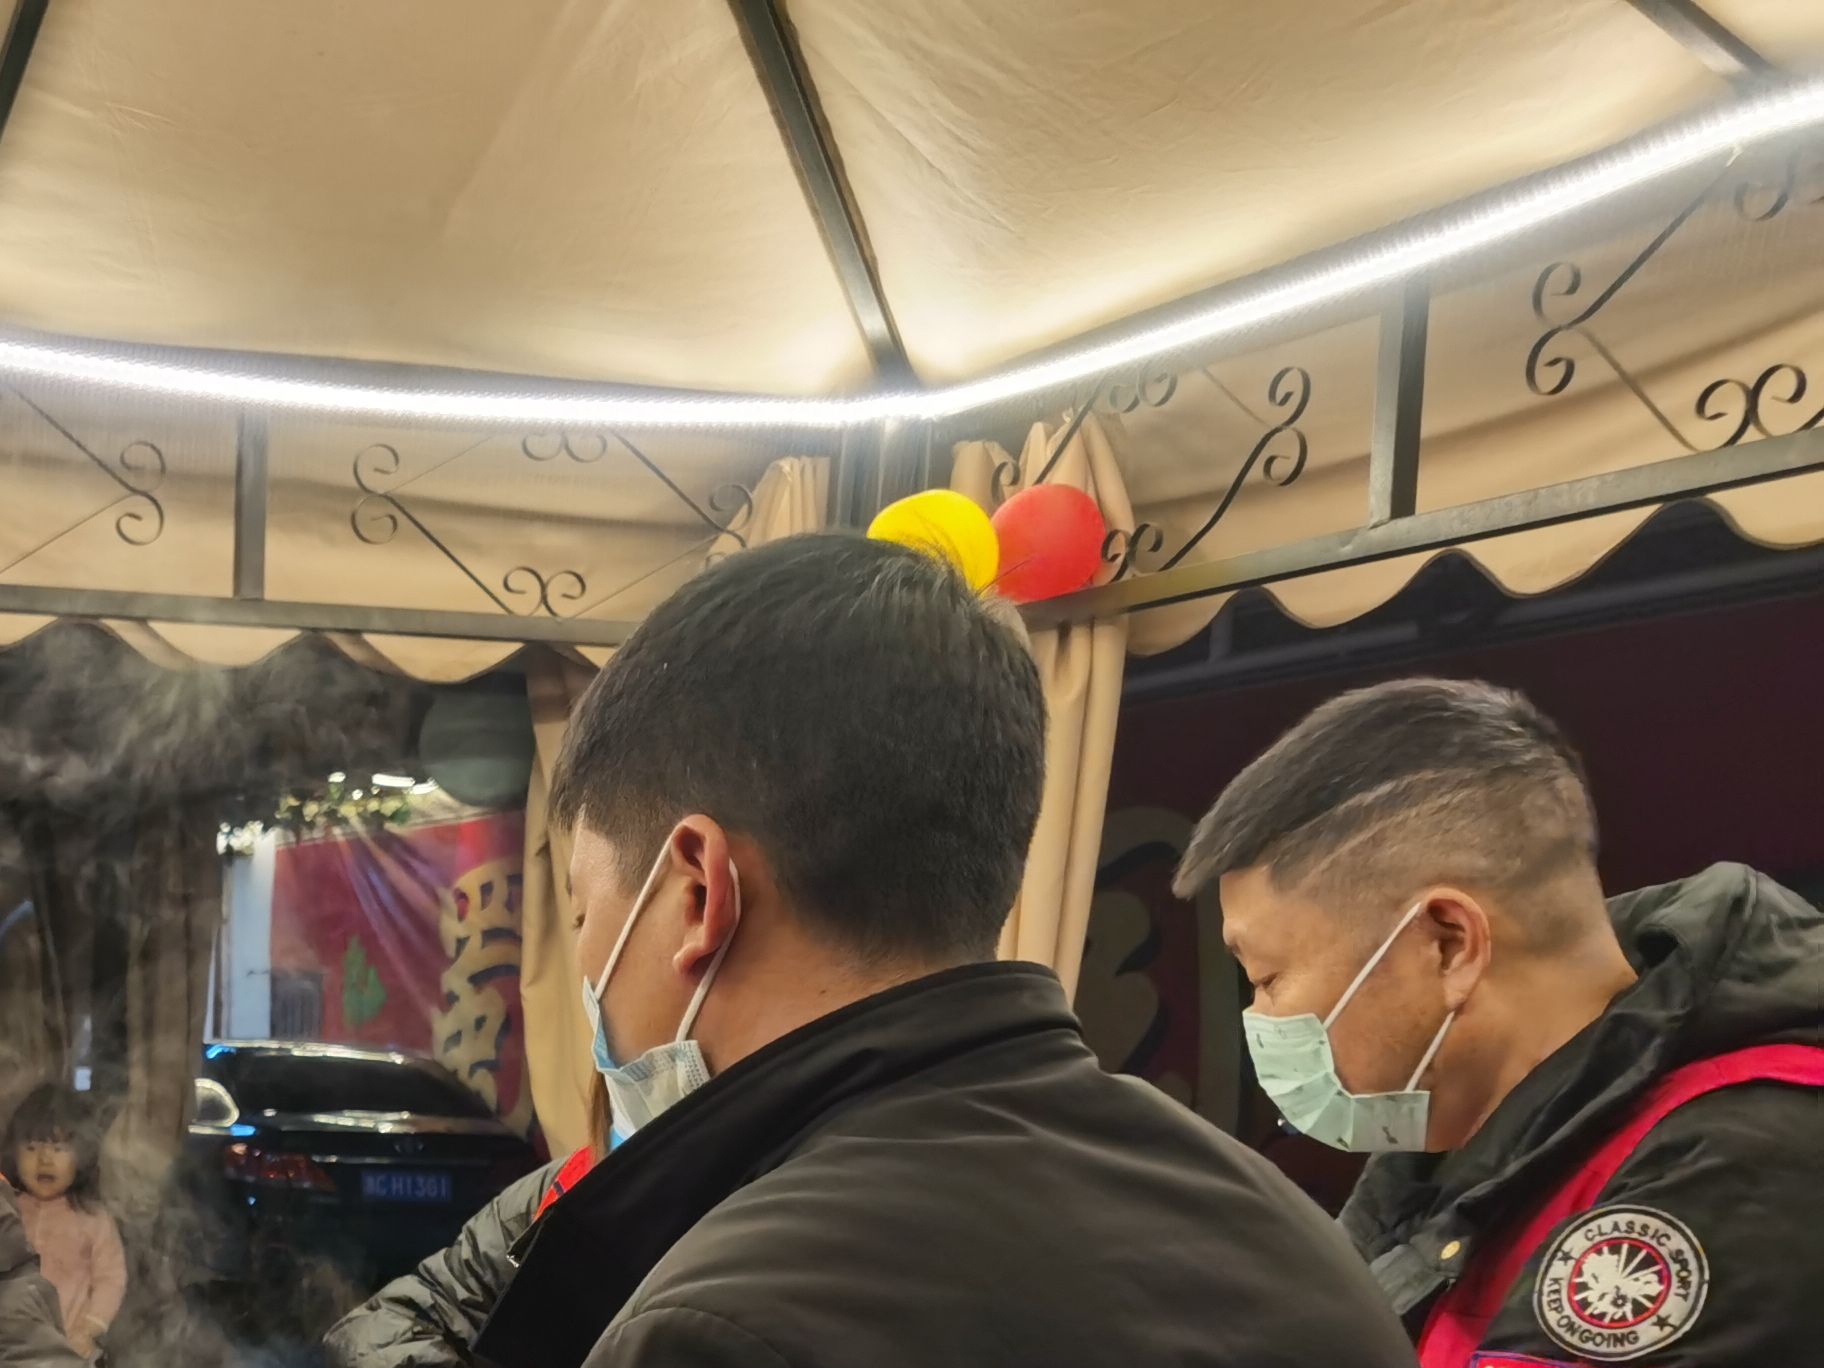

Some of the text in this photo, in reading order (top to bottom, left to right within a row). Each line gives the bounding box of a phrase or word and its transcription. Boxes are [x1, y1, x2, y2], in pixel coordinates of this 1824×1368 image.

[1584, 1220, 1692, 1303] CLASSIC SPORT
[1547, 1277, 1565, 1315] KEEP
